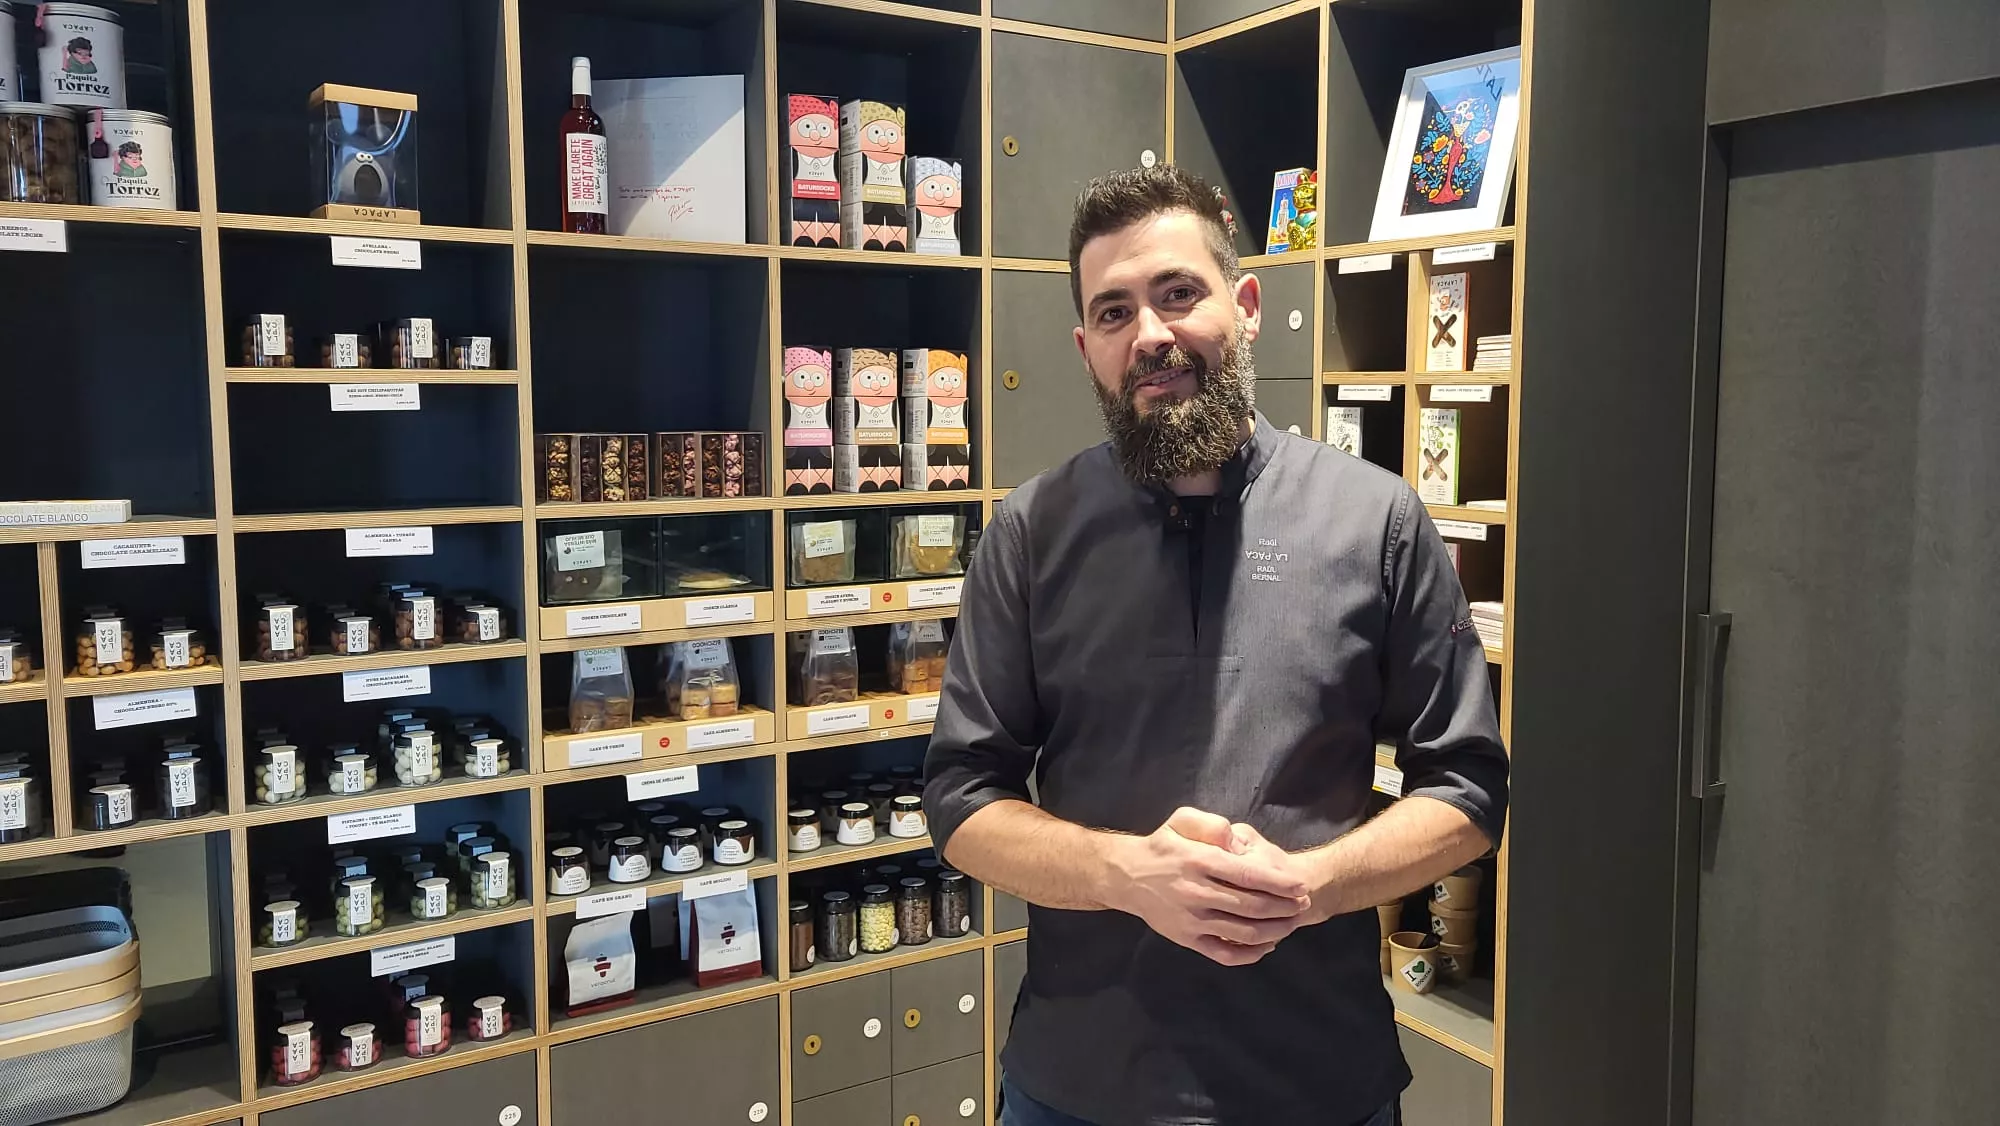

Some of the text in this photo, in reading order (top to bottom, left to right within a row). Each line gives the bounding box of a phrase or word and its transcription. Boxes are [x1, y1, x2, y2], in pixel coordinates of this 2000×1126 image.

[66, 73, 98, 83] Paquita
[54, 78, 110, 95] Torrez
[582, 139, 594, 168] AGAIN
[570, 138, 582, 200] MAKE CLARETE
[116, 177, 148, 186] Paquita
[582, 170, 595, 200] GREAT
[106, 182, 160, 197] Torrez
[797, 184, 836, 192] BATURSOCKS
[353, 207, 396, 218] LAPACA
[47, 513, 88, 522] BLANCO
[1245, 550, 1288, 561] LA PACA
[692, 640, 721, 649] BIZCHOCO
[1405, 970, 1416, 982] I
